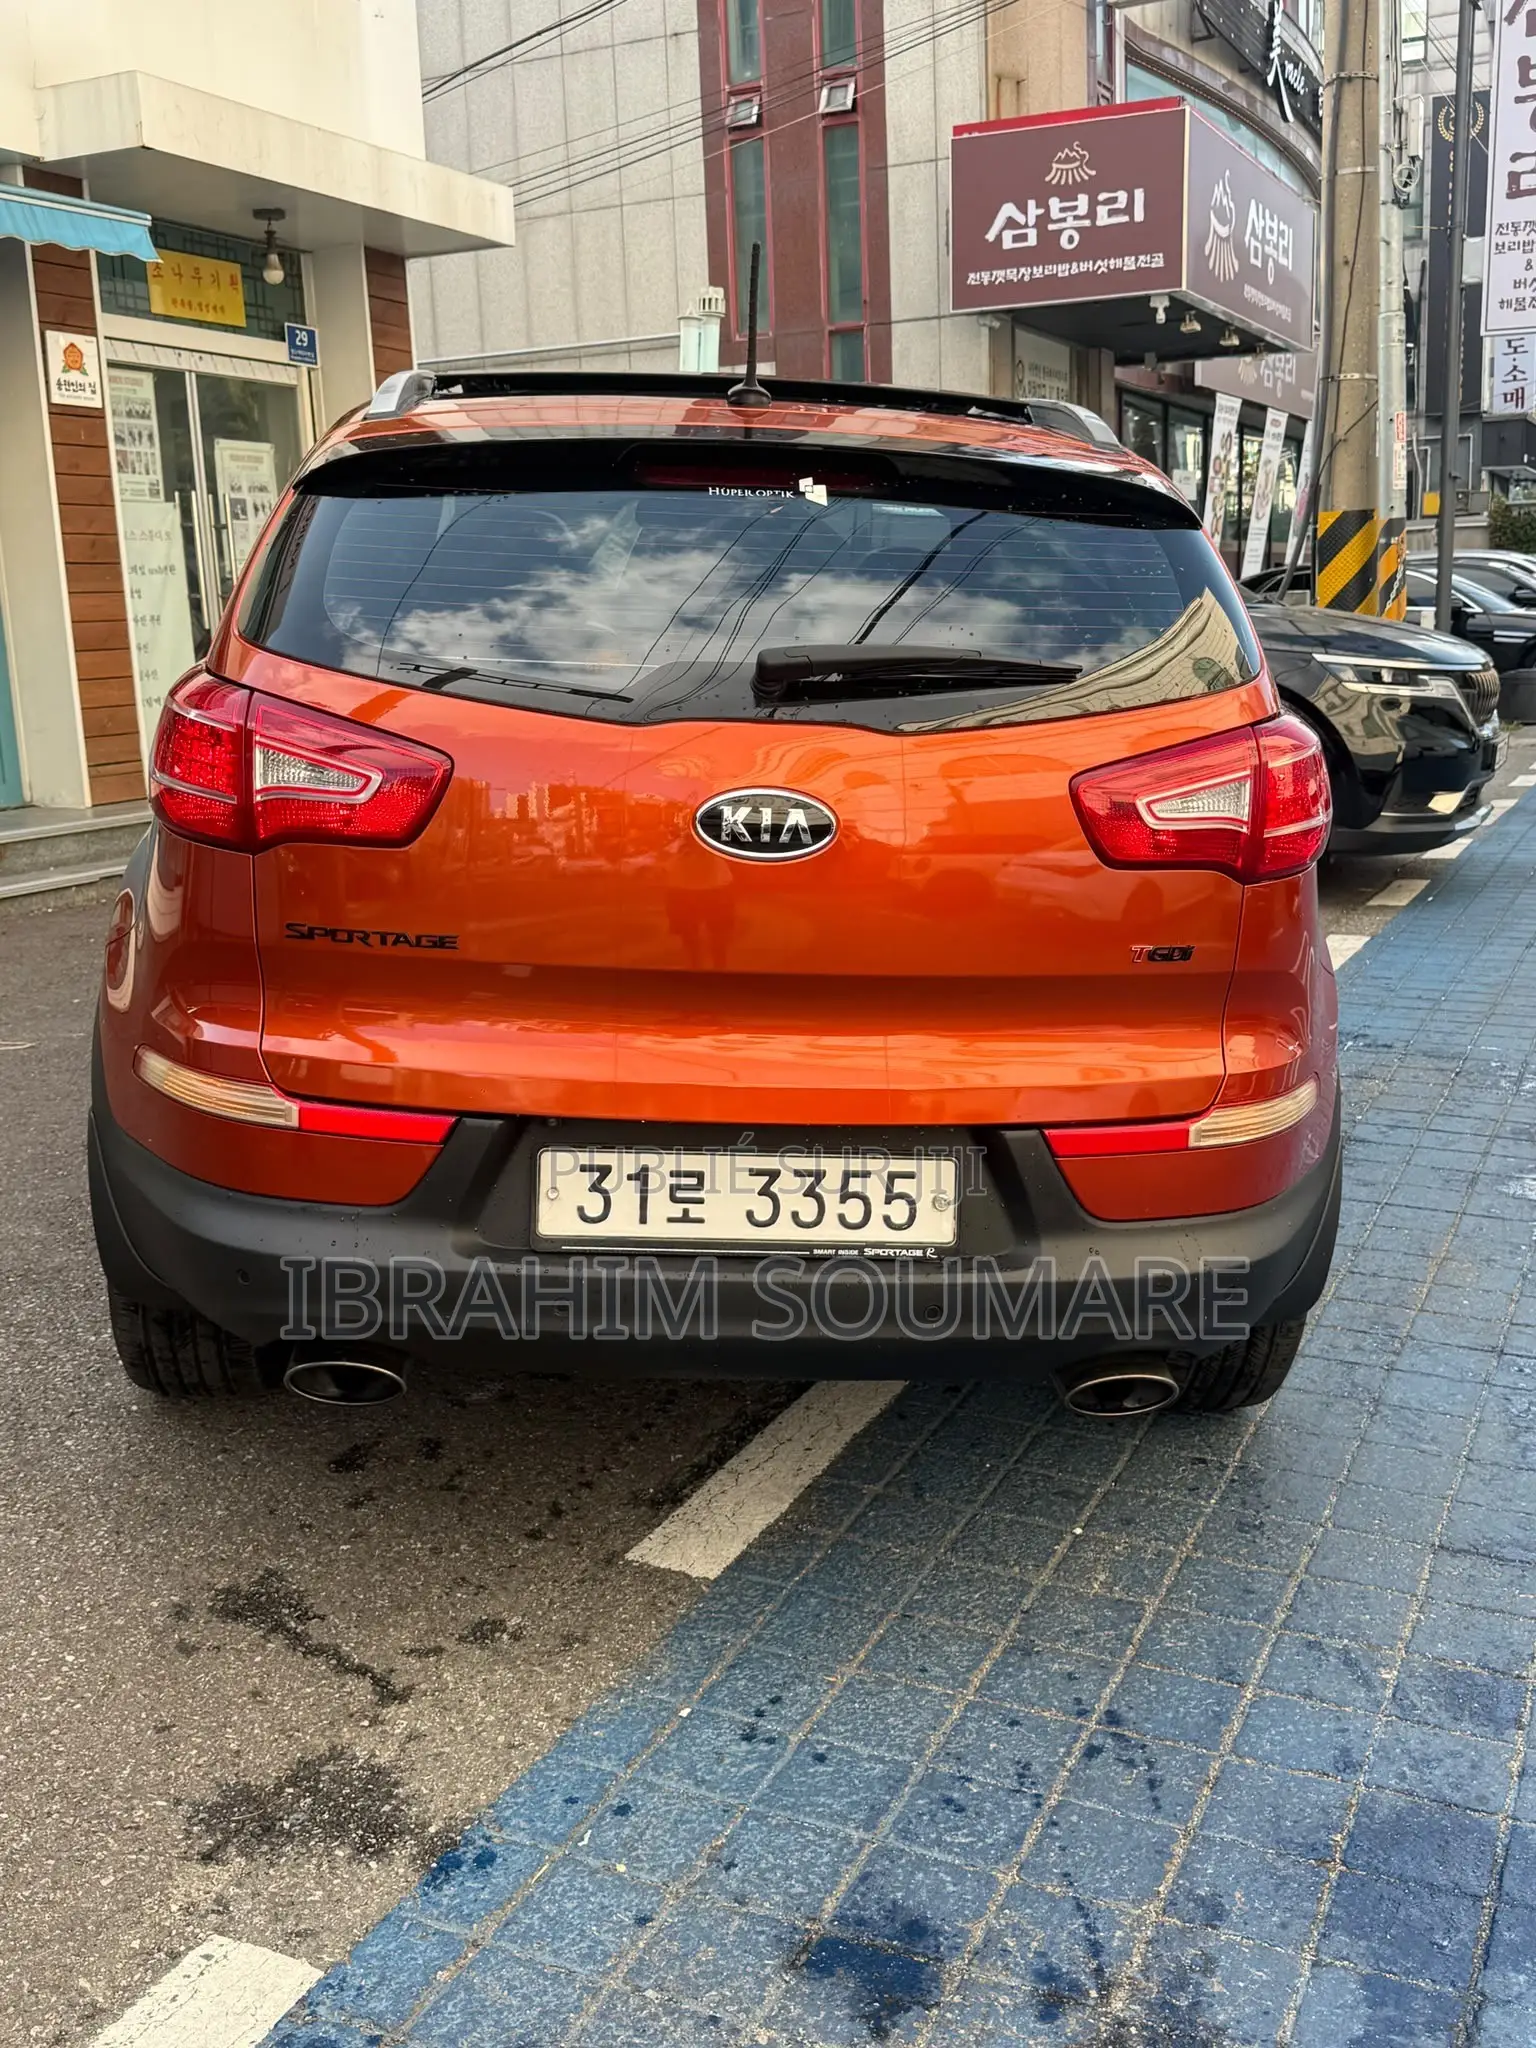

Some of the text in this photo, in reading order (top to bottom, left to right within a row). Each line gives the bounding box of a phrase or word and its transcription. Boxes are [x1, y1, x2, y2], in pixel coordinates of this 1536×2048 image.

[985, 188, 1145, 250] 삼봉리
[1245, 198, 1292, 285] 삼봉리
[295, 329, 309, 347] 29
[719, 806, 813, 845] KIA
[284, 922, 460, 950] SPORTAGE
[576, 1163, 918, 1231] 31로 3355
[813, 1248, 836, 1256] SMART
[863, 1247, 924, 1257] SPORTAGE
